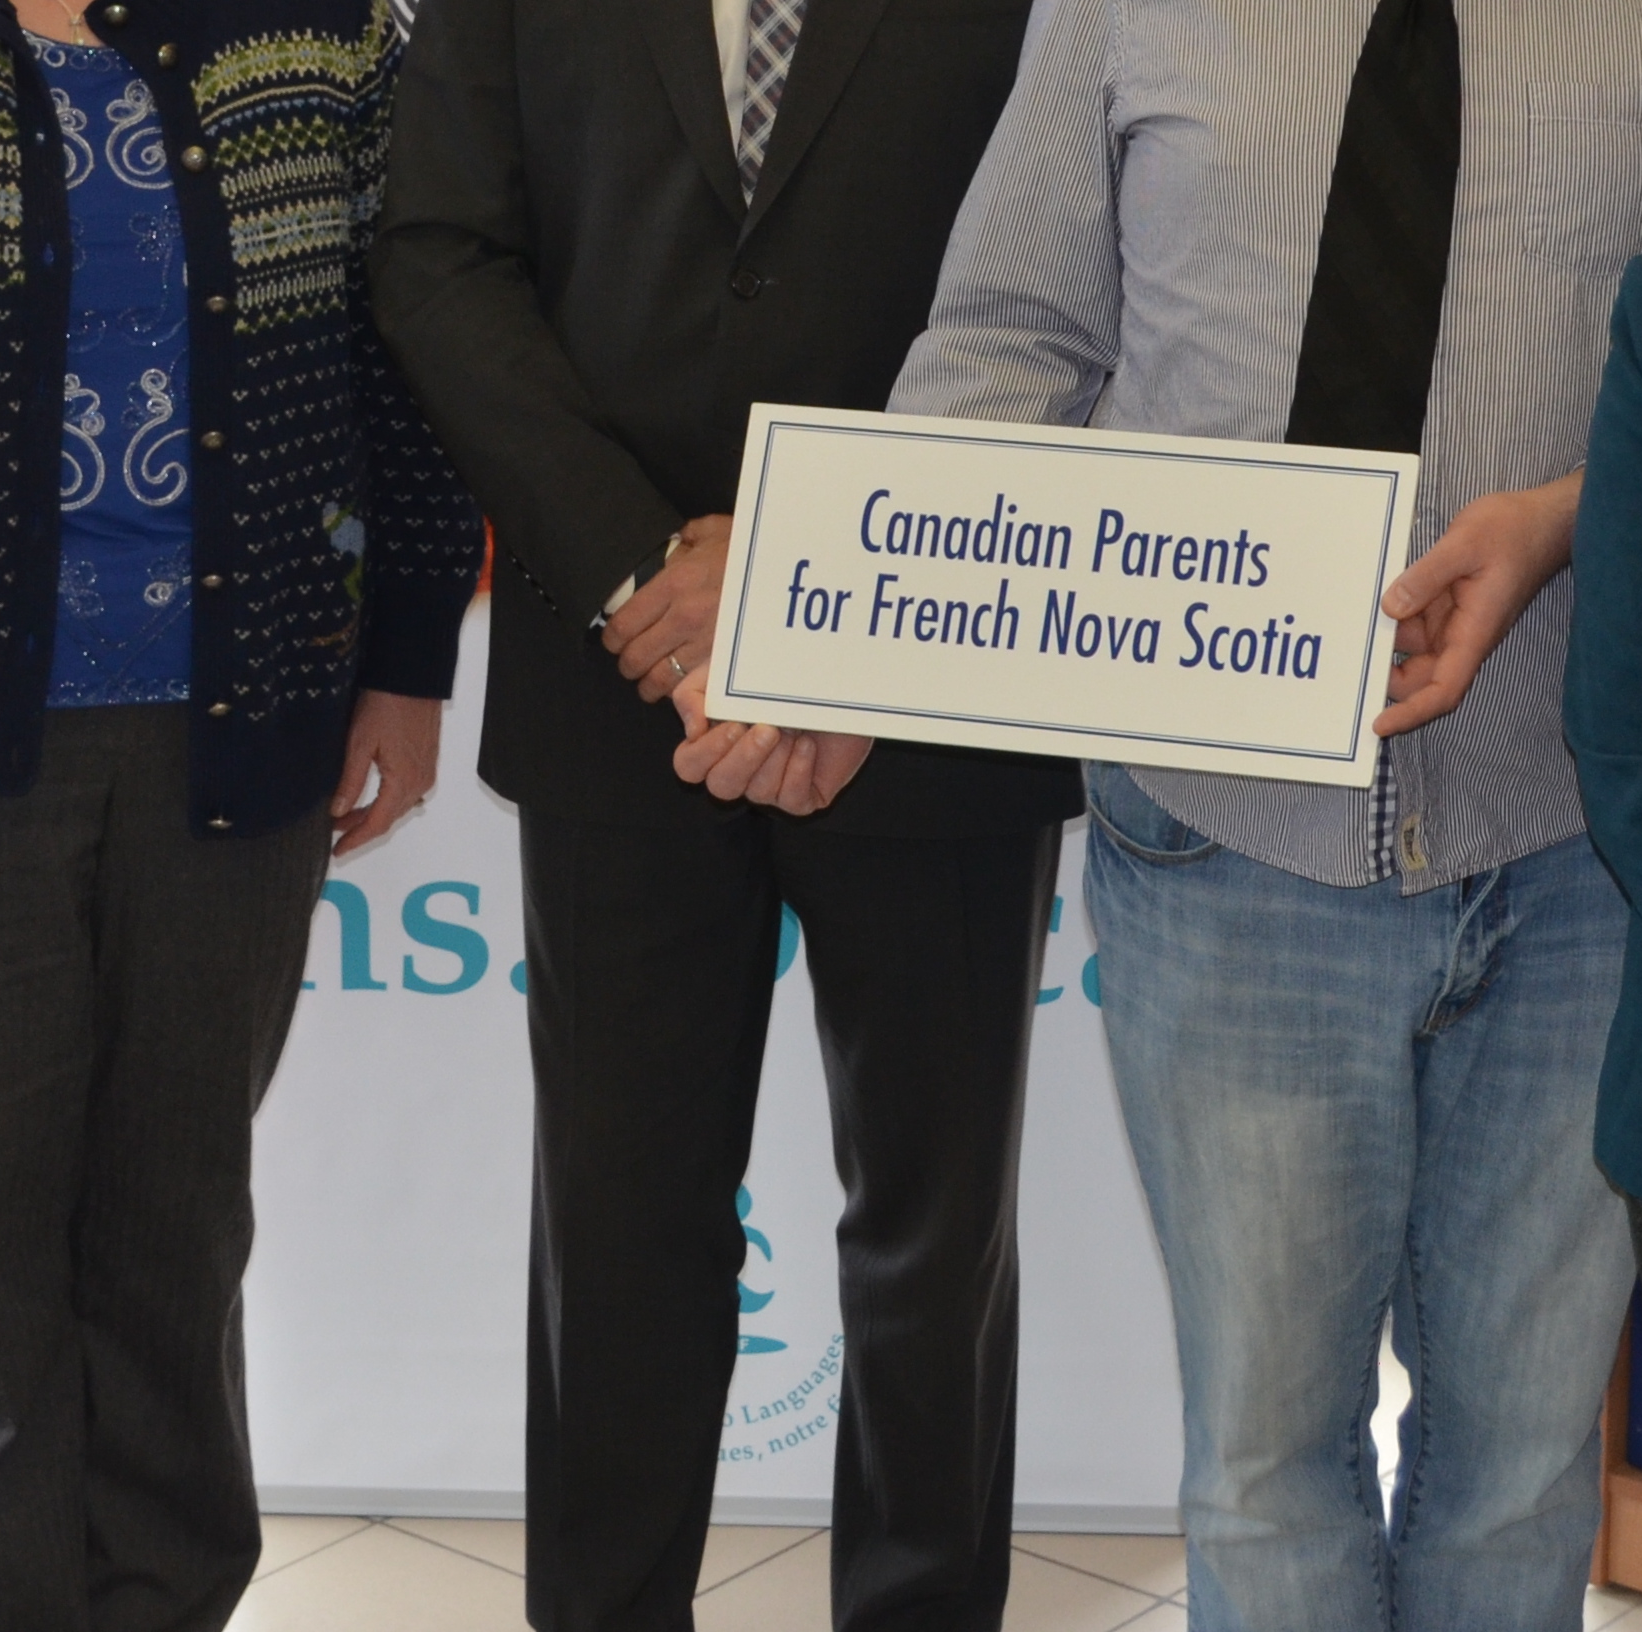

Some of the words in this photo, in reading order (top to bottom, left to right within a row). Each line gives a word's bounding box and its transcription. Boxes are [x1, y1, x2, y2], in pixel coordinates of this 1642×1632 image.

[860, 488, 1073, 571] Canadian
[1091, 506, 1271, 588] Parents
[784, 558, 853, 634] for
[867, 571, 1019, 651] French
[1038, 588, 1161, 666] Nova
[1178, 601, 1323, 680] Scotia
[741, 1332, 845, 1424] Languages
[768, 1414, 829, 1454] notre
